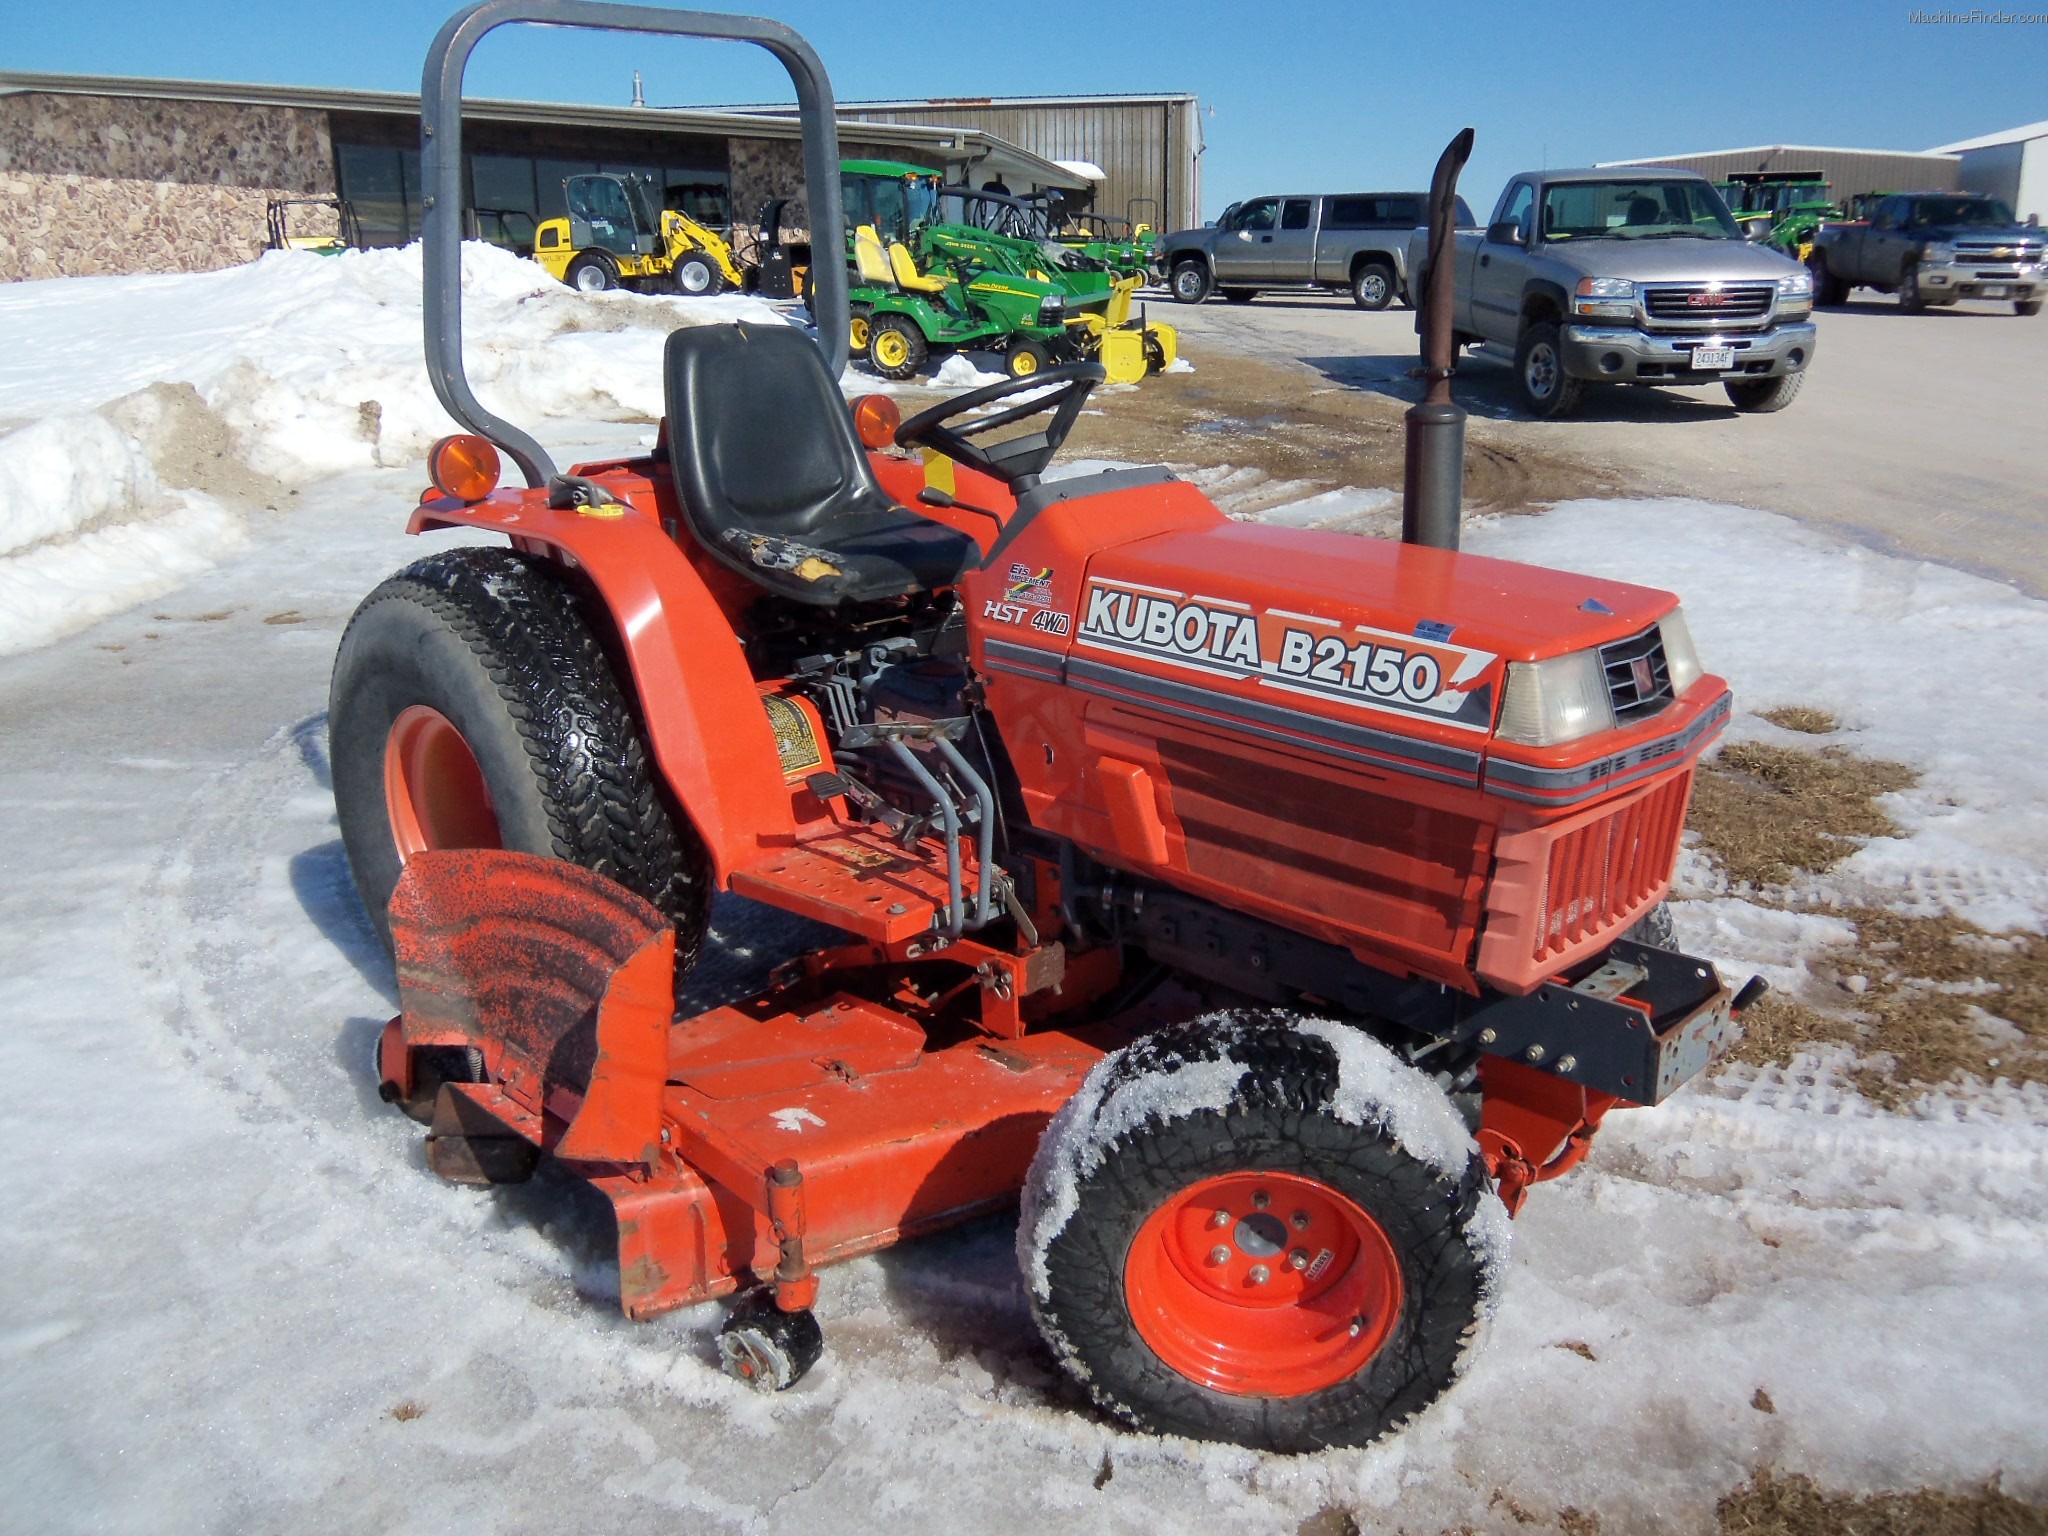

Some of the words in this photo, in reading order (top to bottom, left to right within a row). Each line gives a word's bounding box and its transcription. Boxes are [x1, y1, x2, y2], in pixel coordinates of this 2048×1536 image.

[1688, 293, 1734, 306] GMC
[983, 600, 1028, 625] HST
[1031, 609, 1070, 636] 4WD
[1085, 586, 1262, 669] KUBOTA
[1278, 627, 1441, 703] B2150
